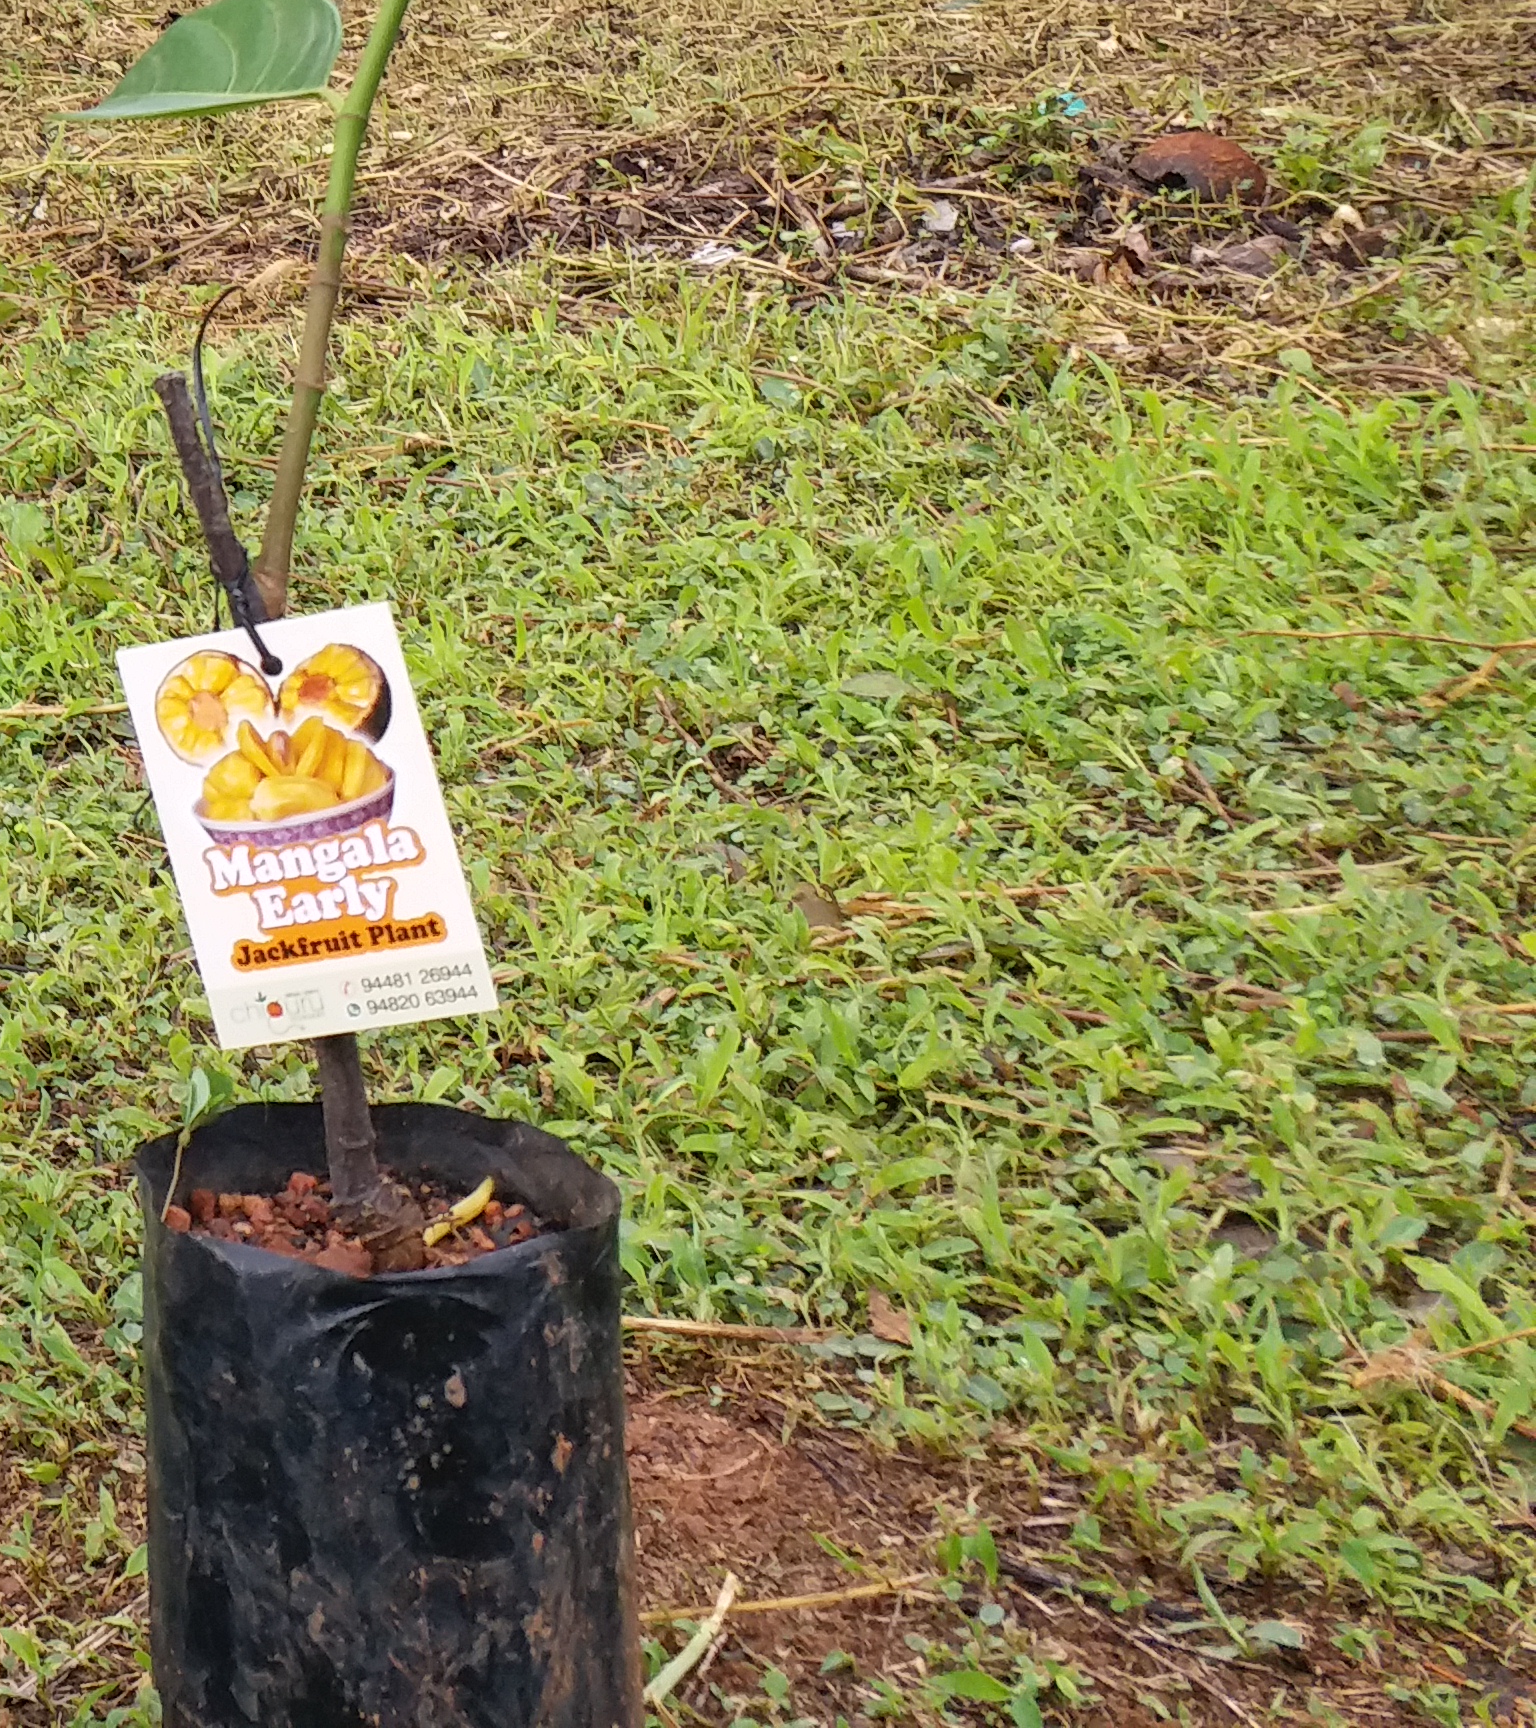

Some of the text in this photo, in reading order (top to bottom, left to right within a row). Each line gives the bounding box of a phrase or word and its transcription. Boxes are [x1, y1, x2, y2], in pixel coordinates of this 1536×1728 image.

[205, 823, 419, 892] Mangala
[252, 875, 392, 930] Early
[236, 918, 441, 966] Jackfruit Plant
[361, 963, 473, 993] 94481 26944
[366, 985, 479, 1015] 94820 63944
